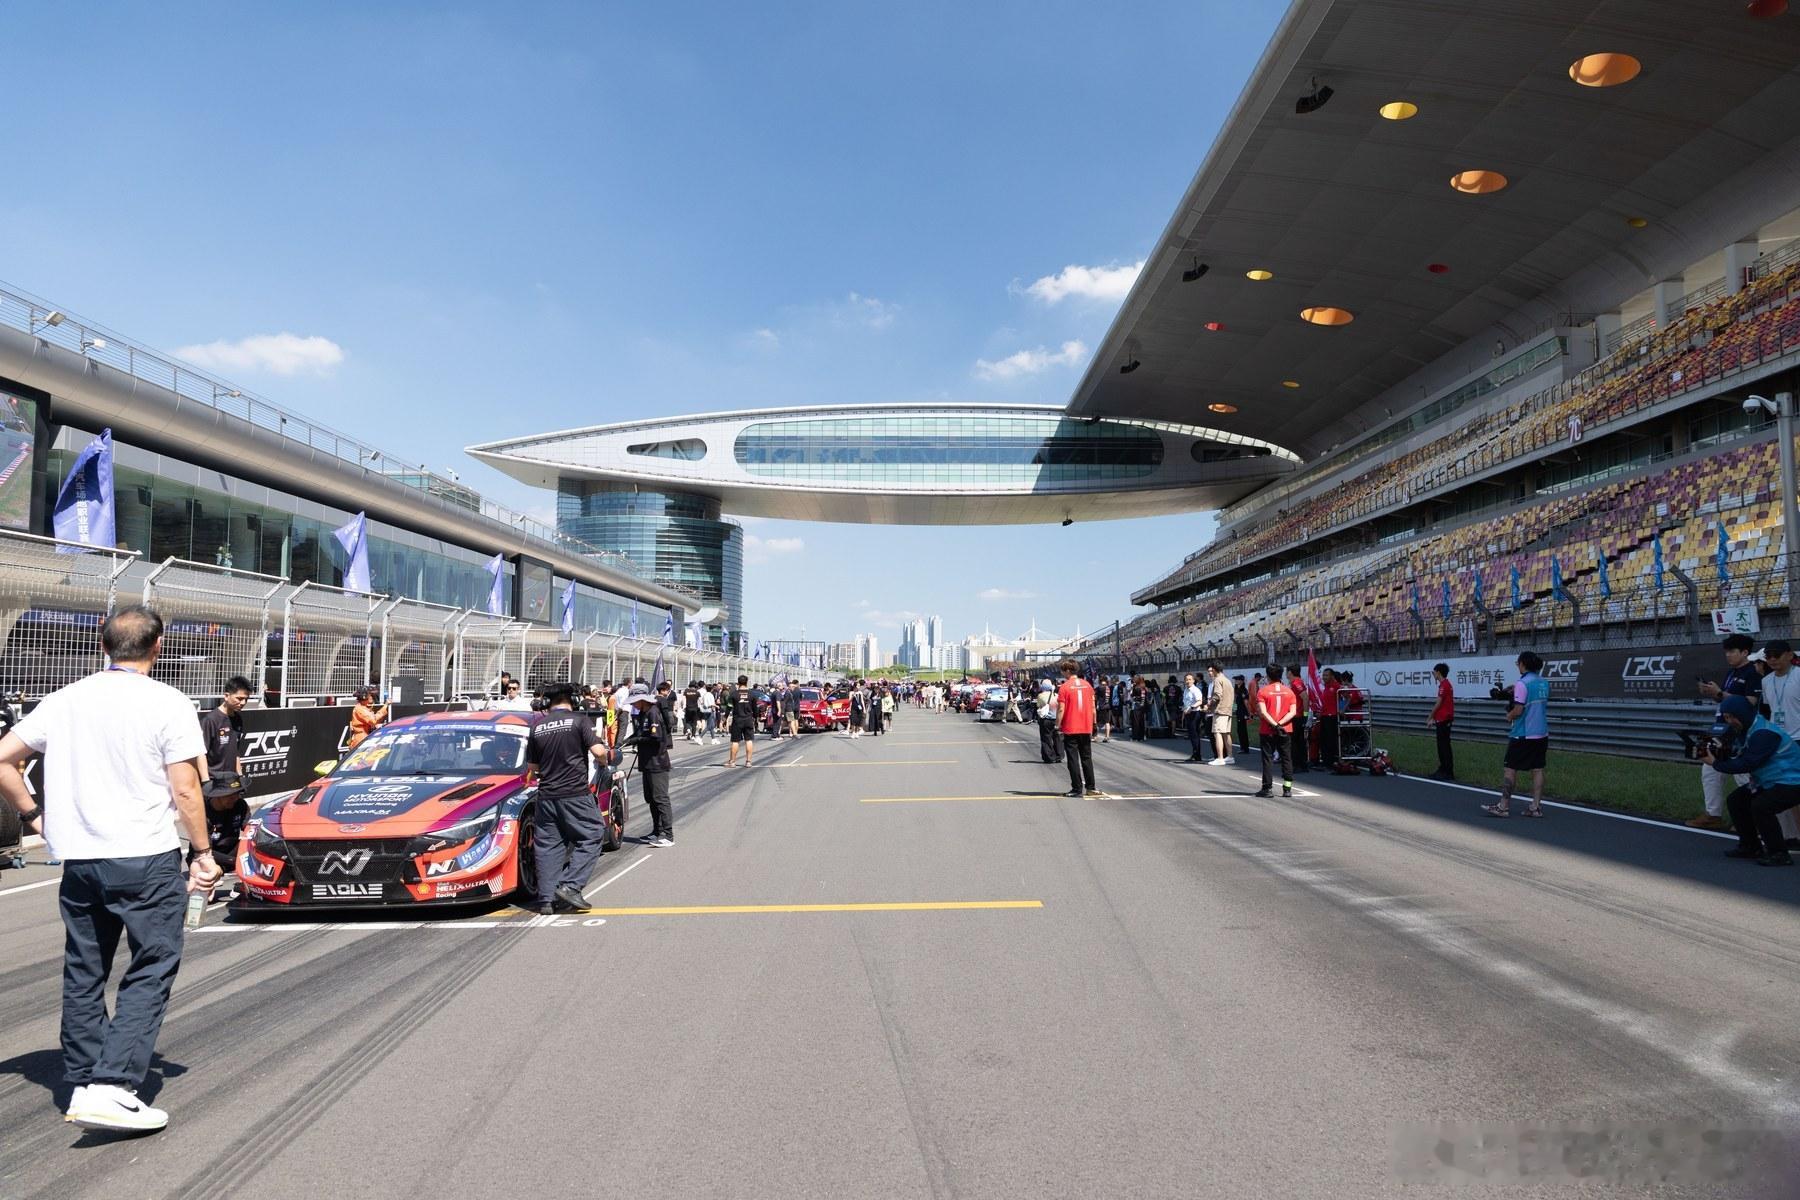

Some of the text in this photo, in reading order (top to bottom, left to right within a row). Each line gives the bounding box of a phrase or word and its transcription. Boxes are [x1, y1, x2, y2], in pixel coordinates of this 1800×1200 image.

[1456, 670, 1505, 685] 奇瑞汽车
[240, 730, 291, 756] PCC
